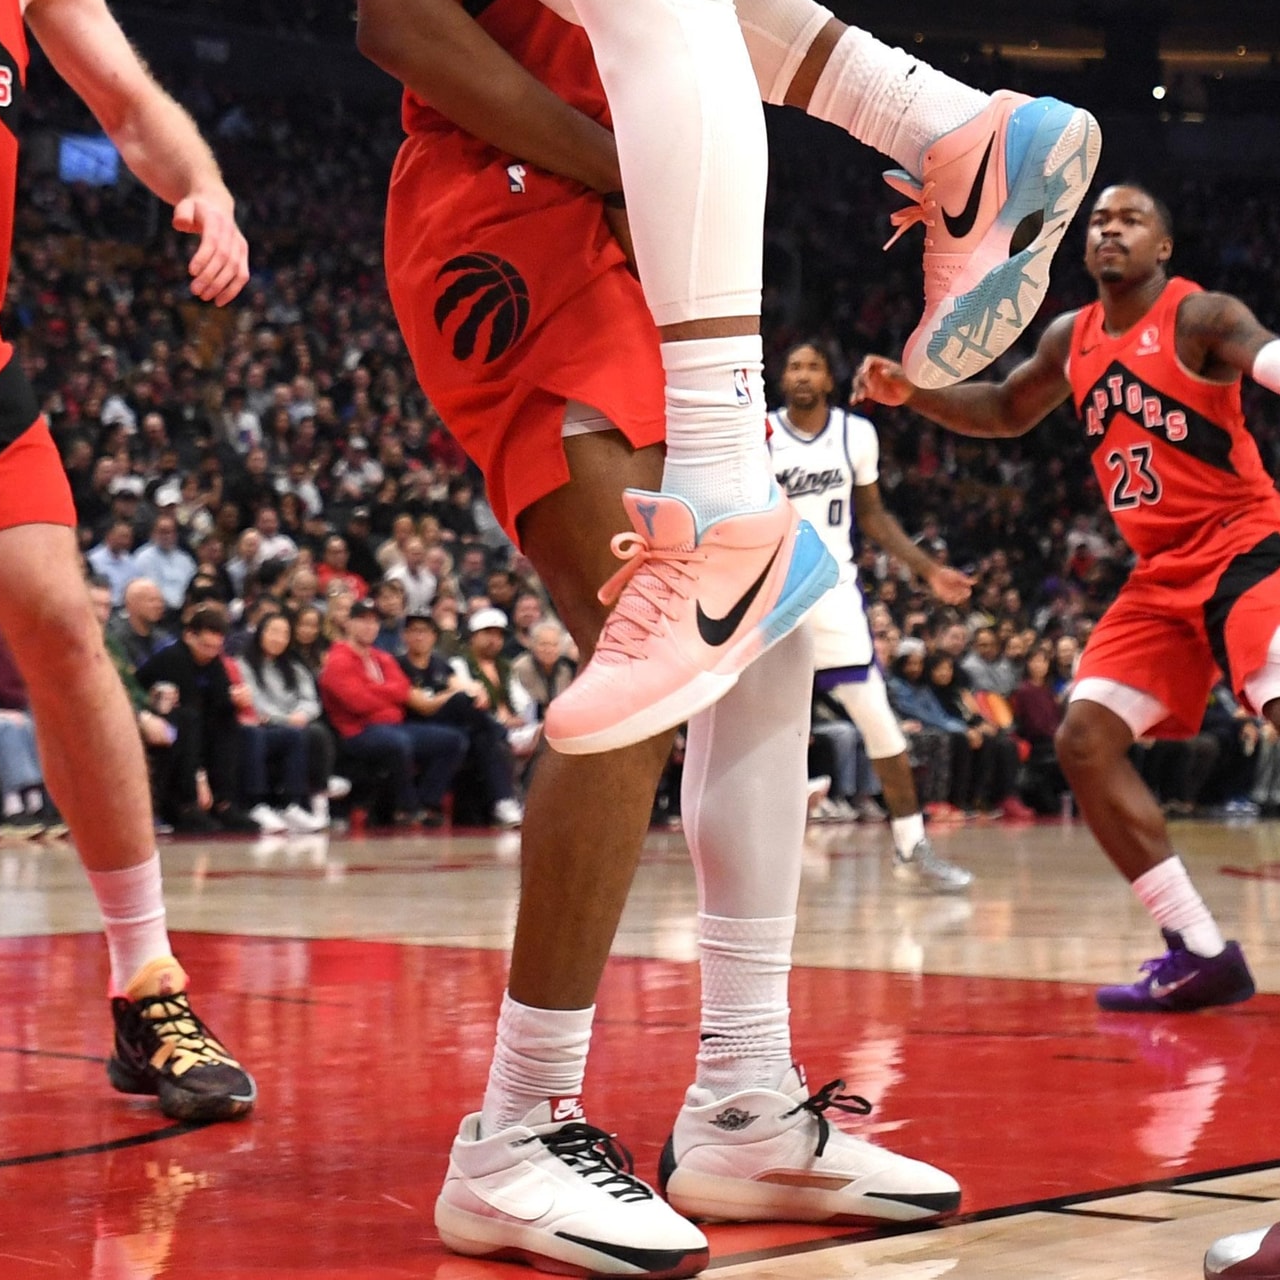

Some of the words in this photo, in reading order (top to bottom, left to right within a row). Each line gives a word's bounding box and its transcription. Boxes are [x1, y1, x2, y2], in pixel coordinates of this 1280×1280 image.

[1086, 373, 1189, 442] APTORS
[775, 466, 845, 498] Kings
[1105, 441, 1163, 512] 23
[828, 499, 843, 526] 0
